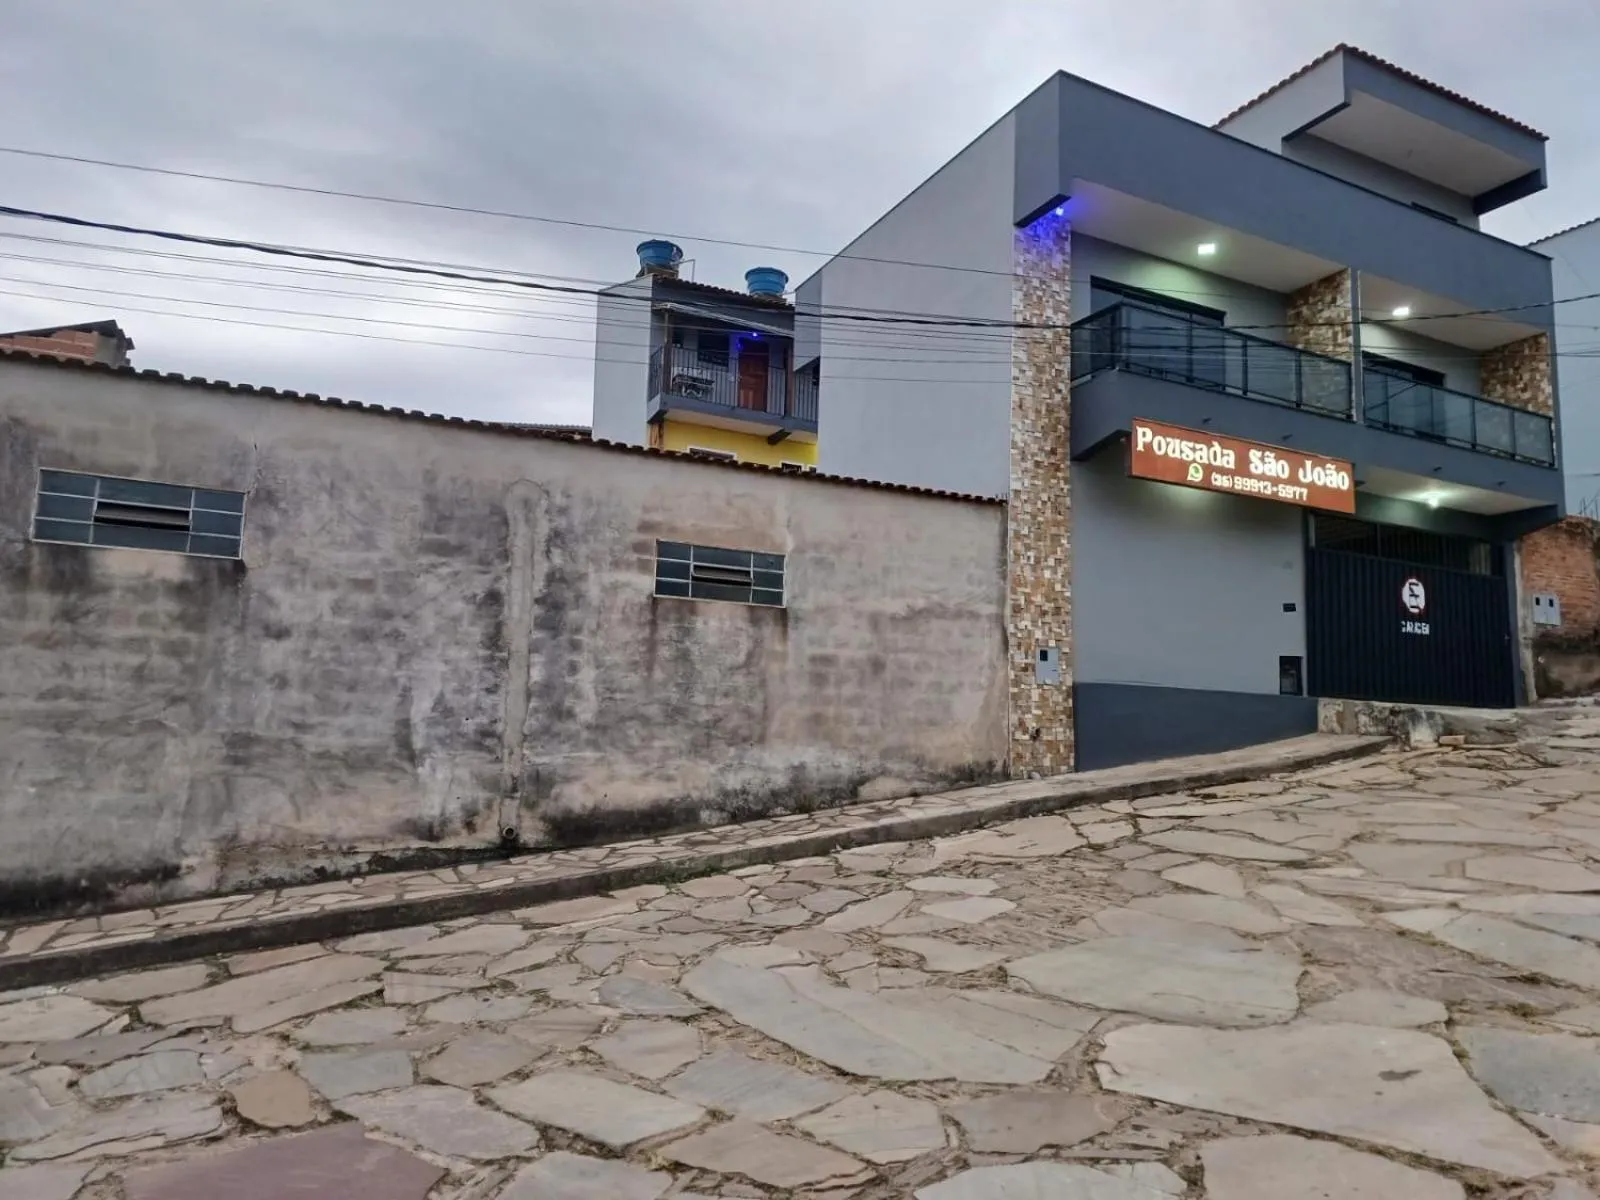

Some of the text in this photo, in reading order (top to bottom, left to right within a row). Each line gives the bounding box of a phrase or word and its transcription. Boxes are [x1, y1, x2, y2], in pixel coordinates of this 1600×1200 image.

[1136, 426, 1349, 490] Pousada São João
